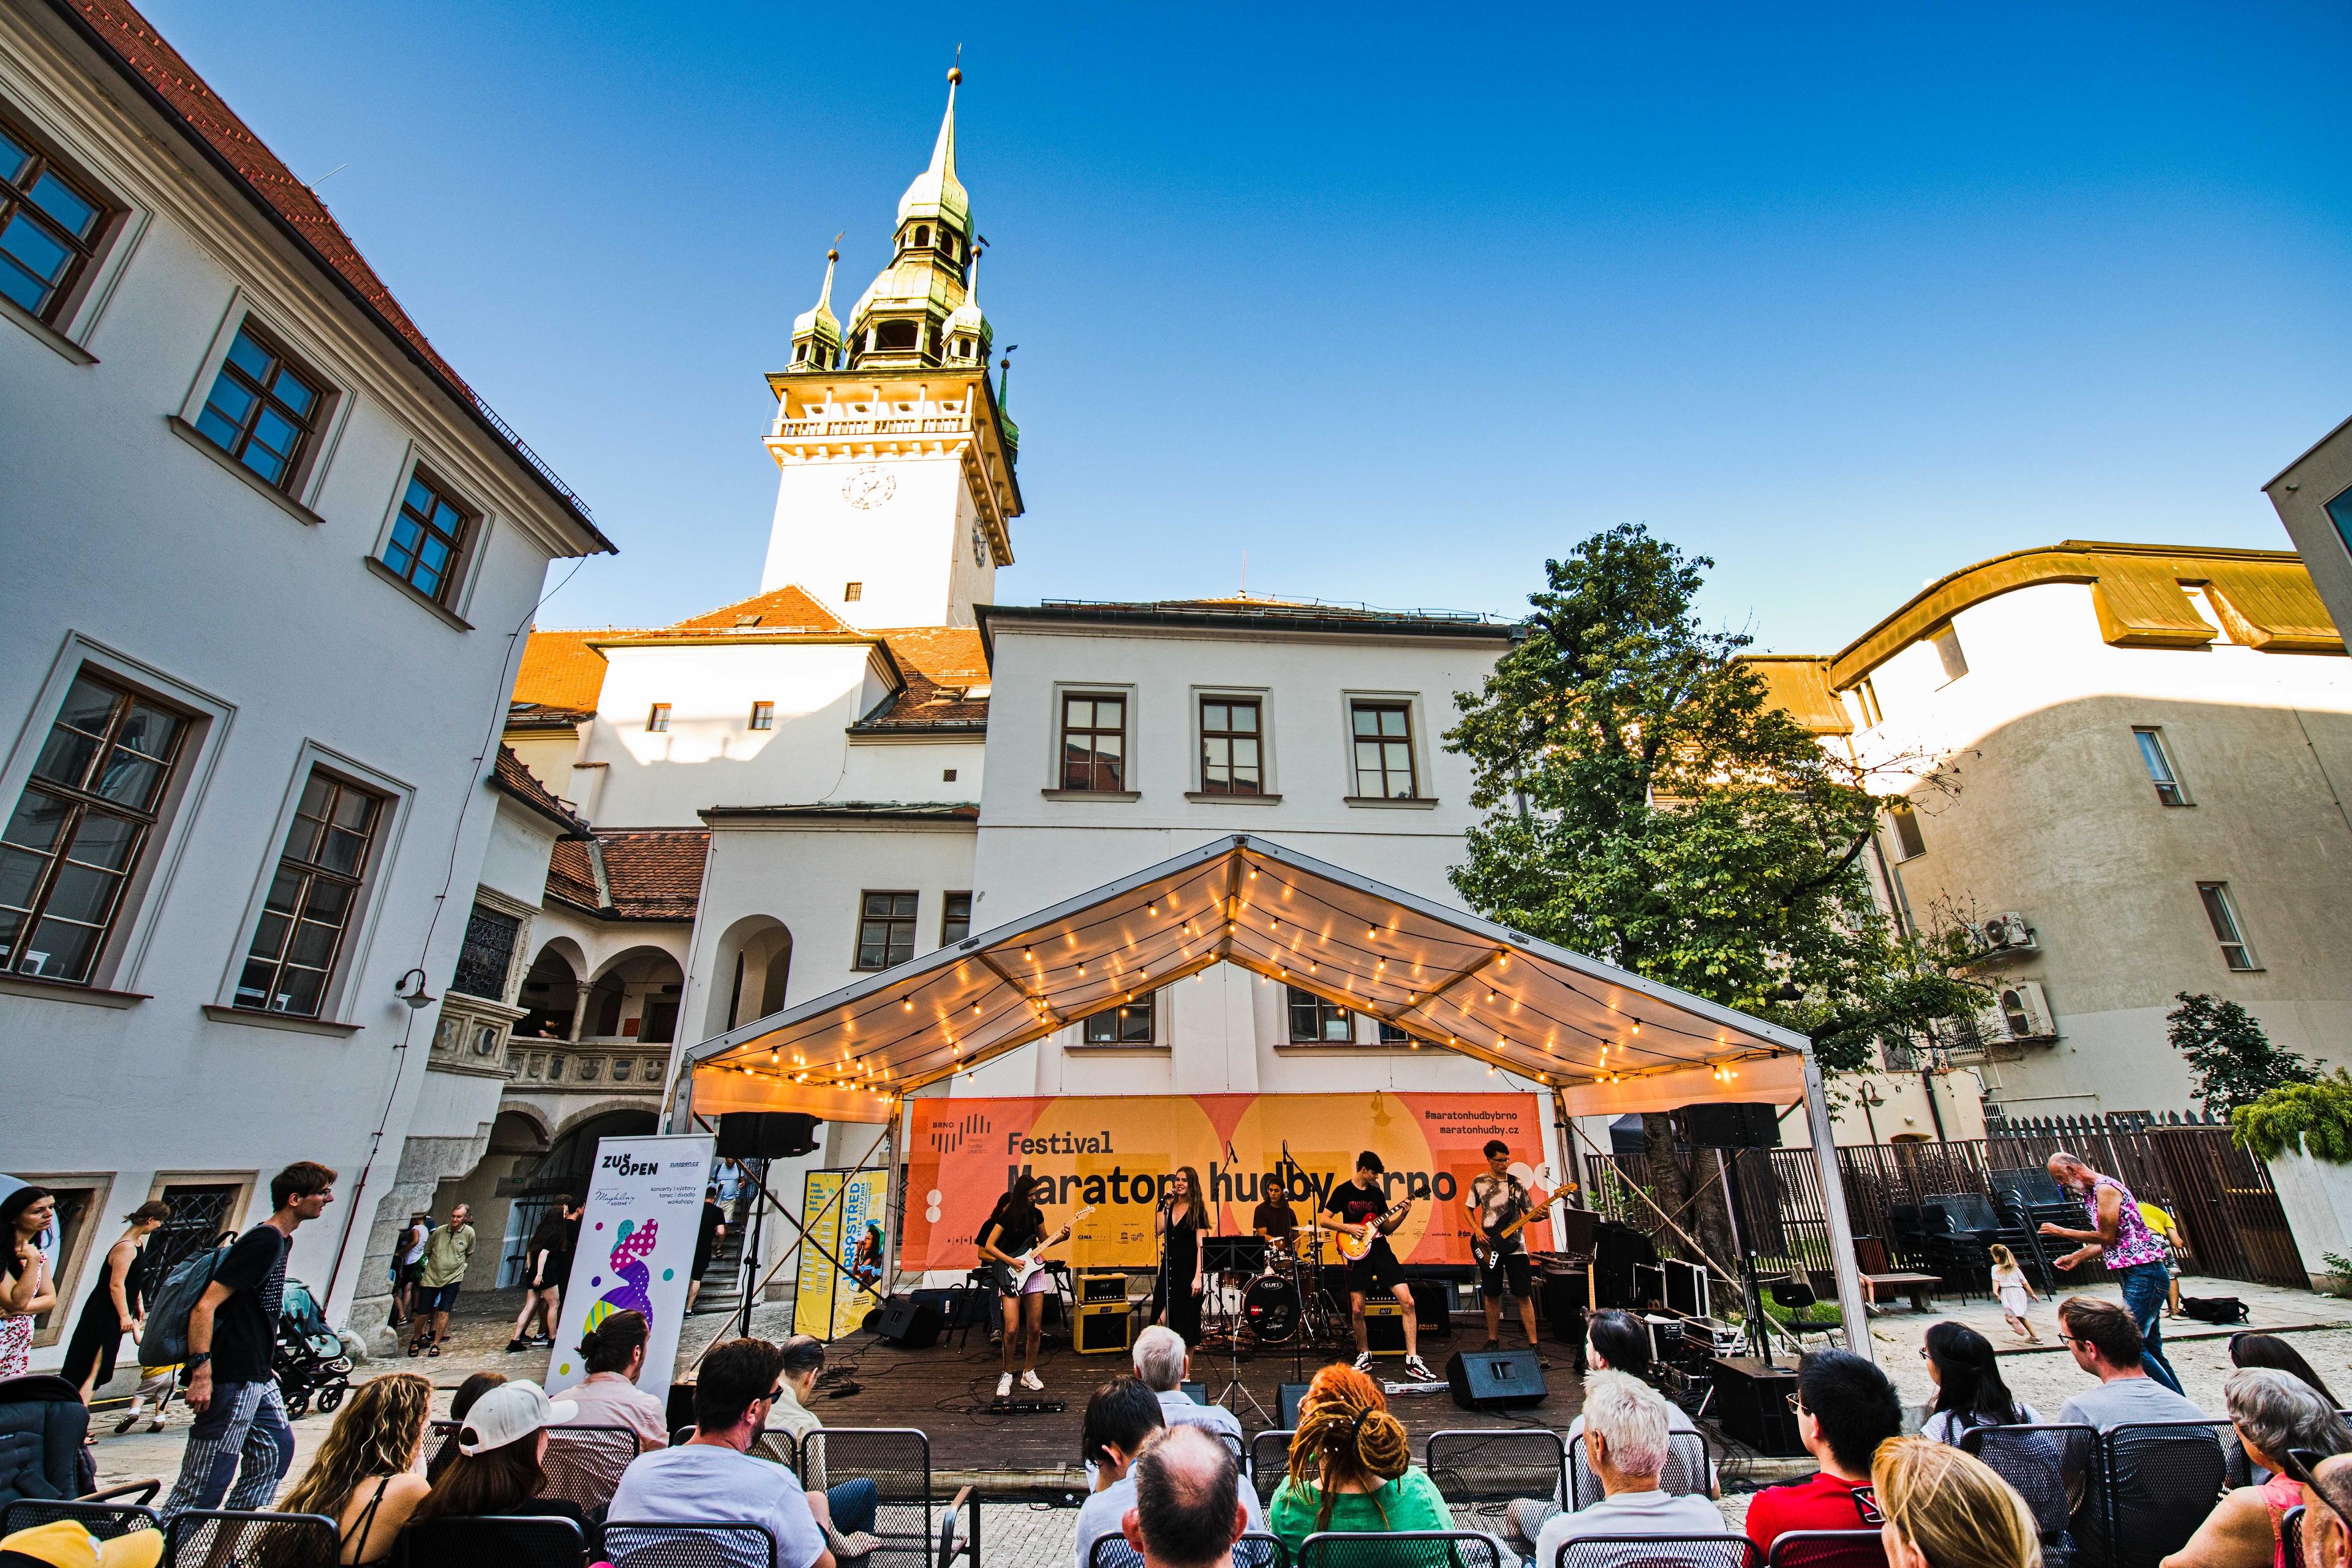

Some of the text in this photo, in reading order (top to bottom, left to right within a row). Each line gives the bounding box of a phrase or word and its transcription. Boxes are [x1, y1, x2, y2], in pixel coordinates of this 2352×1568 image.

[1425, 1110, 1518, 1121] #maratonhudbybrno
[1440, 1125, 1519, 1136] maratonhudby.cz
[1008, 1131, 1114, 1155] Festival
[602, 1153, 631, 1168] ZUŠ
[619, 1163, 659, 1177] OPEN
[1356, 1161, 1457, 1201] rno
